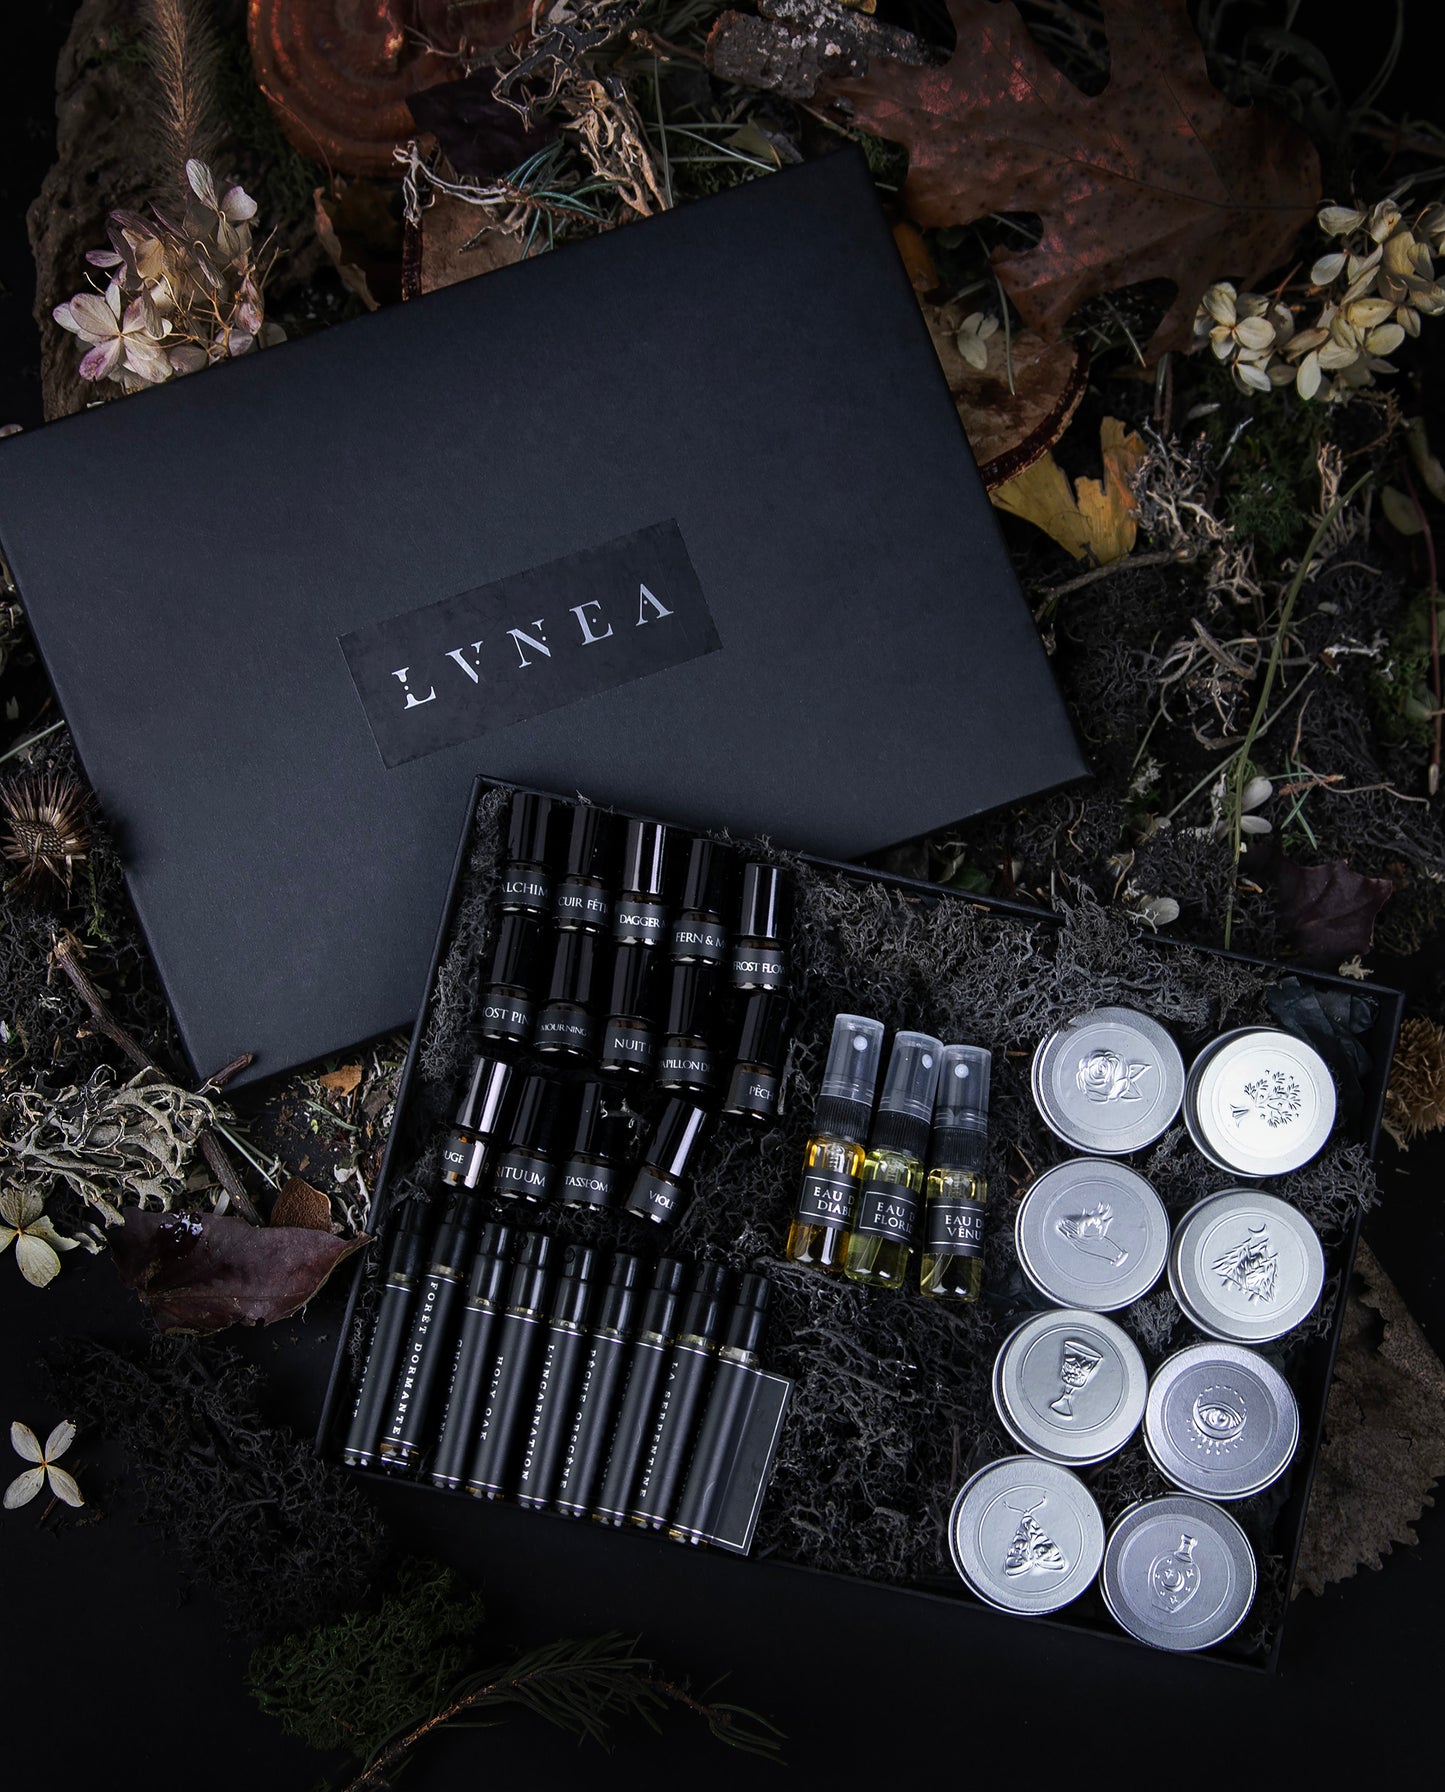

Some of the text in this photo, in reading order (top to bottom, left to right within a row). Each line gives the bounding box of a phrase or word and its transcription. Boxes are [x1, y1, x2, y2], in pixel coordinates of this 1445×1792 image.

[390, 582, 674, 711] LVNEA
[557, 896, 583, 908] CUIR
[619, 914, 660, 928] DAGGER
[675, 931, 704, 944] FERN
[705, 935, 714, 946] &
[732, 961, 760, 972] FROST
[540, 1023, 588, 1037] MOURNING
[614, 1038, 646, 1052] NUIT
[813, 1186, 843, 1202] EAU
[876, 1201, 905, 1218] EAU
[945, 1213, 972, 1228] EAU
[418, 1281, 441, 1335] FORÊT
[578, 1348, 599, 1403] PÊCHE
[392, 1342, 423, 1436] DORMANTE
[479, 1355, 504, 1441] HOLY OAK
[521, 1344, 555, 1481] L'INCARNATION
[639, 1361, 679, 1498] LA SERPENTINE
